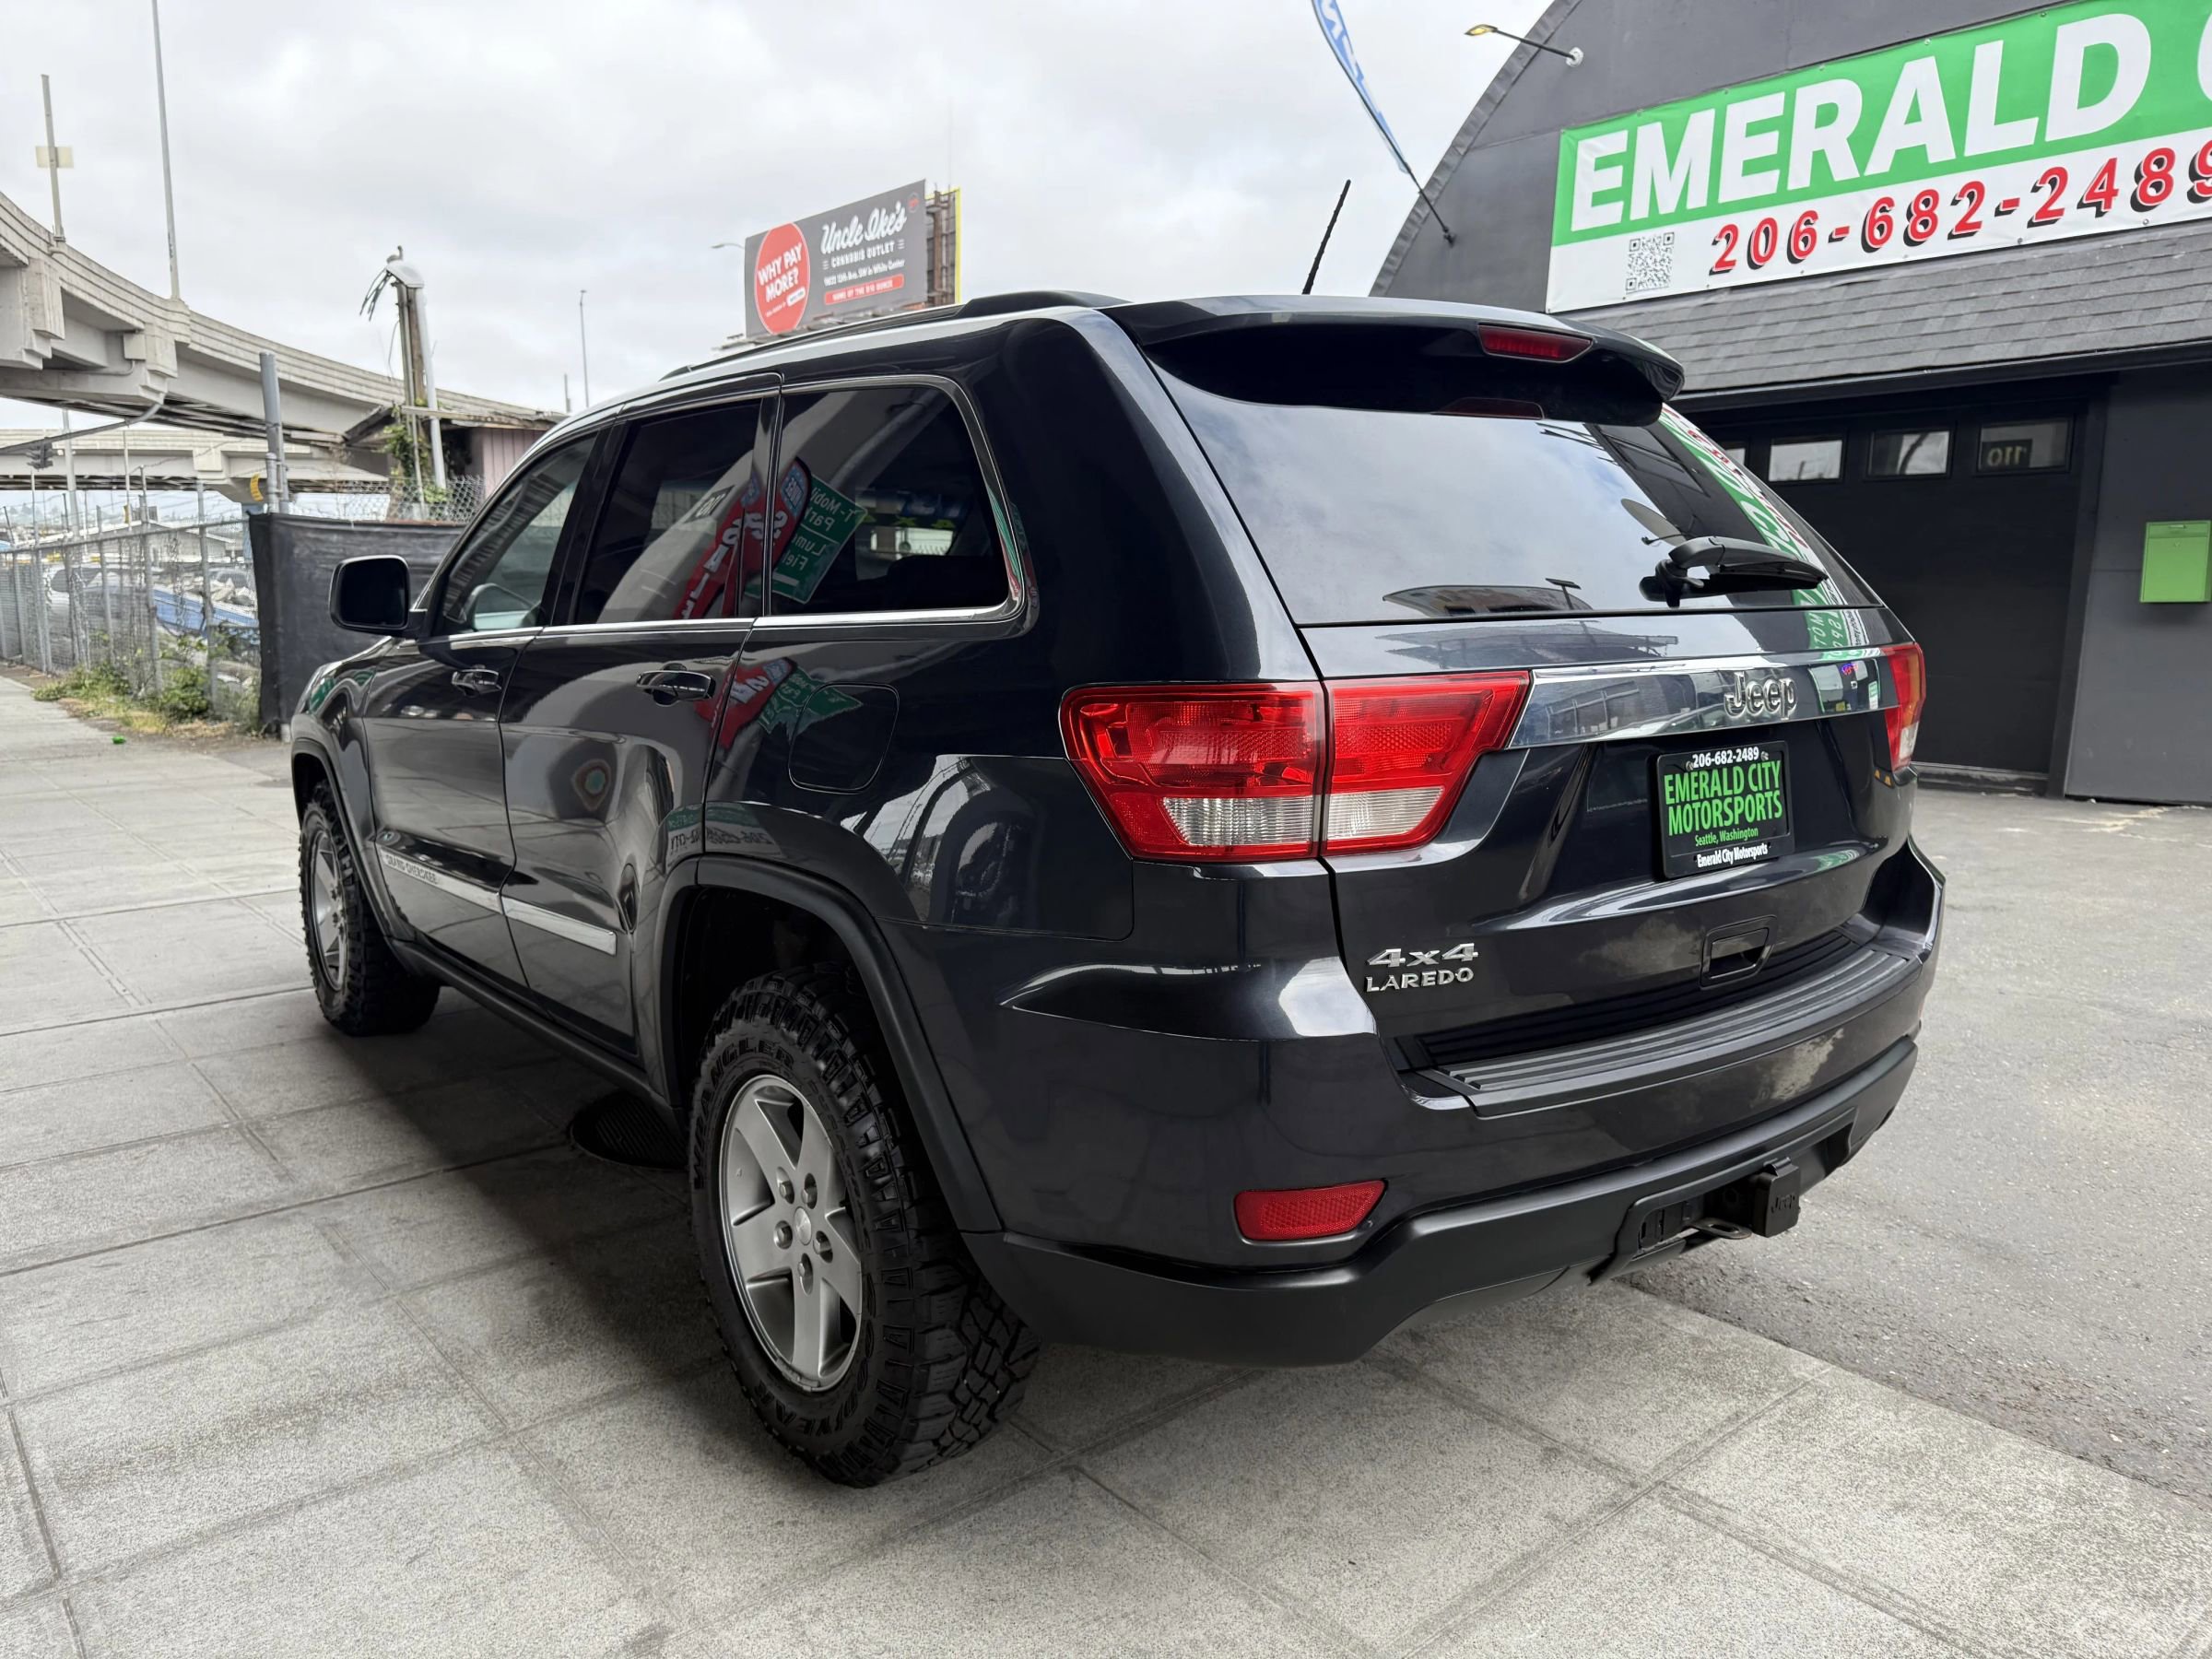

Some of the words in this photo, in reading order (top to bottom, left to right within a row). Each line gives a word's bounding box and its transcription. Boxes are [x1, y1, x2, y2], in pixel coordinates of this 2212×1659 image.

[1571, 13, 2151, 231] EMERALD
[820, 215, 864, 254] Uncle
[864, 200, 908, 241] Ike's
[758, 256, 782, 286] WHY
[783, 241, 803, 269] PAY
[866, 240, 895, 259] OUTLET
[766, 266, 799, 302] MORE?
[1724, 670, 1797, 723] Jeep
[1692, 747, 1759, 769] 206-682-2489
[1664, 766, 1745, 805] EMERALD
[1747, 759, 1782, 792] CITY
[1668, 790, 1783, 836] MOTORSPORTS
[1695, 832, 1719, 847] Seattle,
[1719, 827, 1759, 842] Washington
[1697, 850, 1722, 868] Emerald
[1722, 849, 1735, 865] City
[1734, 842, 1768, 861] Motorsports
[1367, 942, 1478, 968] 4x4
[1365, 967, 1475, 993] LAREDO
[693, 1037, 794, 1190] WRANGLER
[1771, 1194, 1796, 1214] Jeep
[752, 1273, 877, 1438] GOODYEAR
